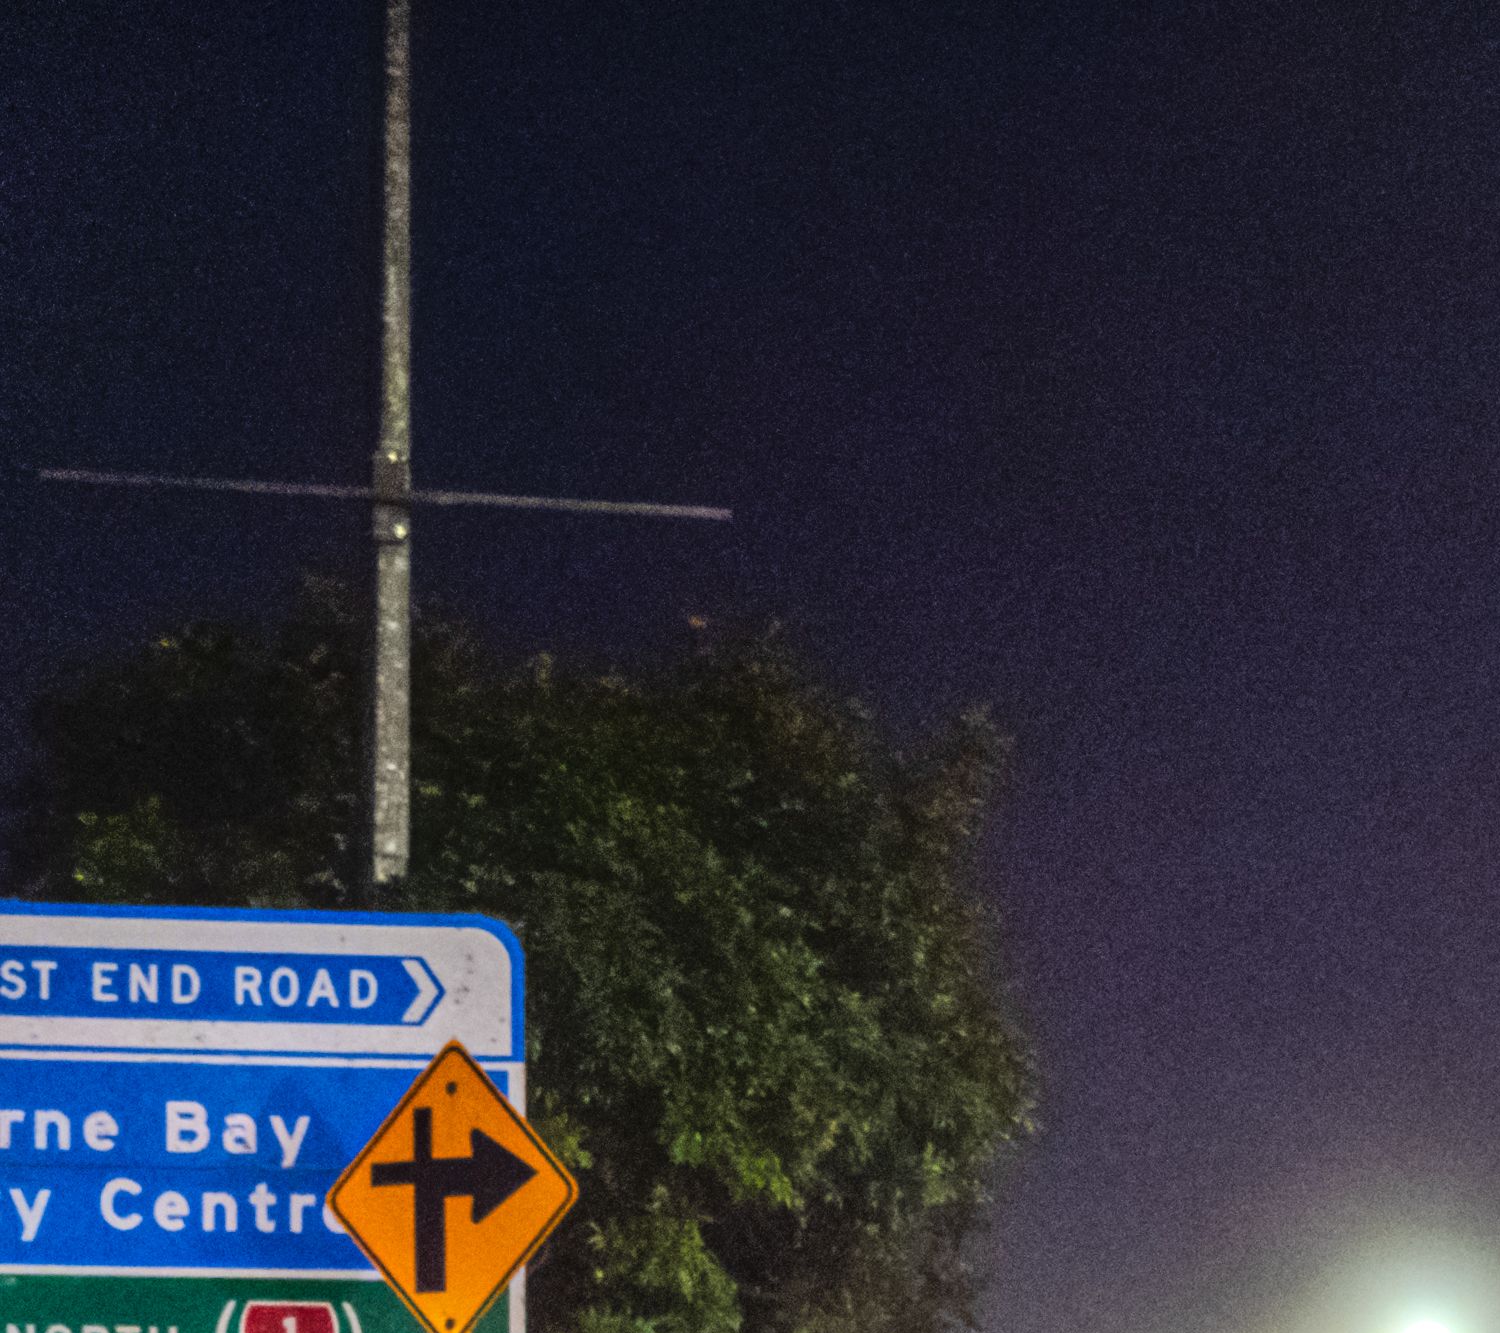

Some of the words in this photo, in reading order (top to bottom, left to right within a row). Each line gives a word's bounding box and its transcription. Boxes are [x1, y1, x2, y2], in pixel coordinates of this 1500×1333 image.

[91, 962, 201, 1004] END
[234, 966, 378, 1009] ROAD
[166, 1102, 310, 1167] Bay
